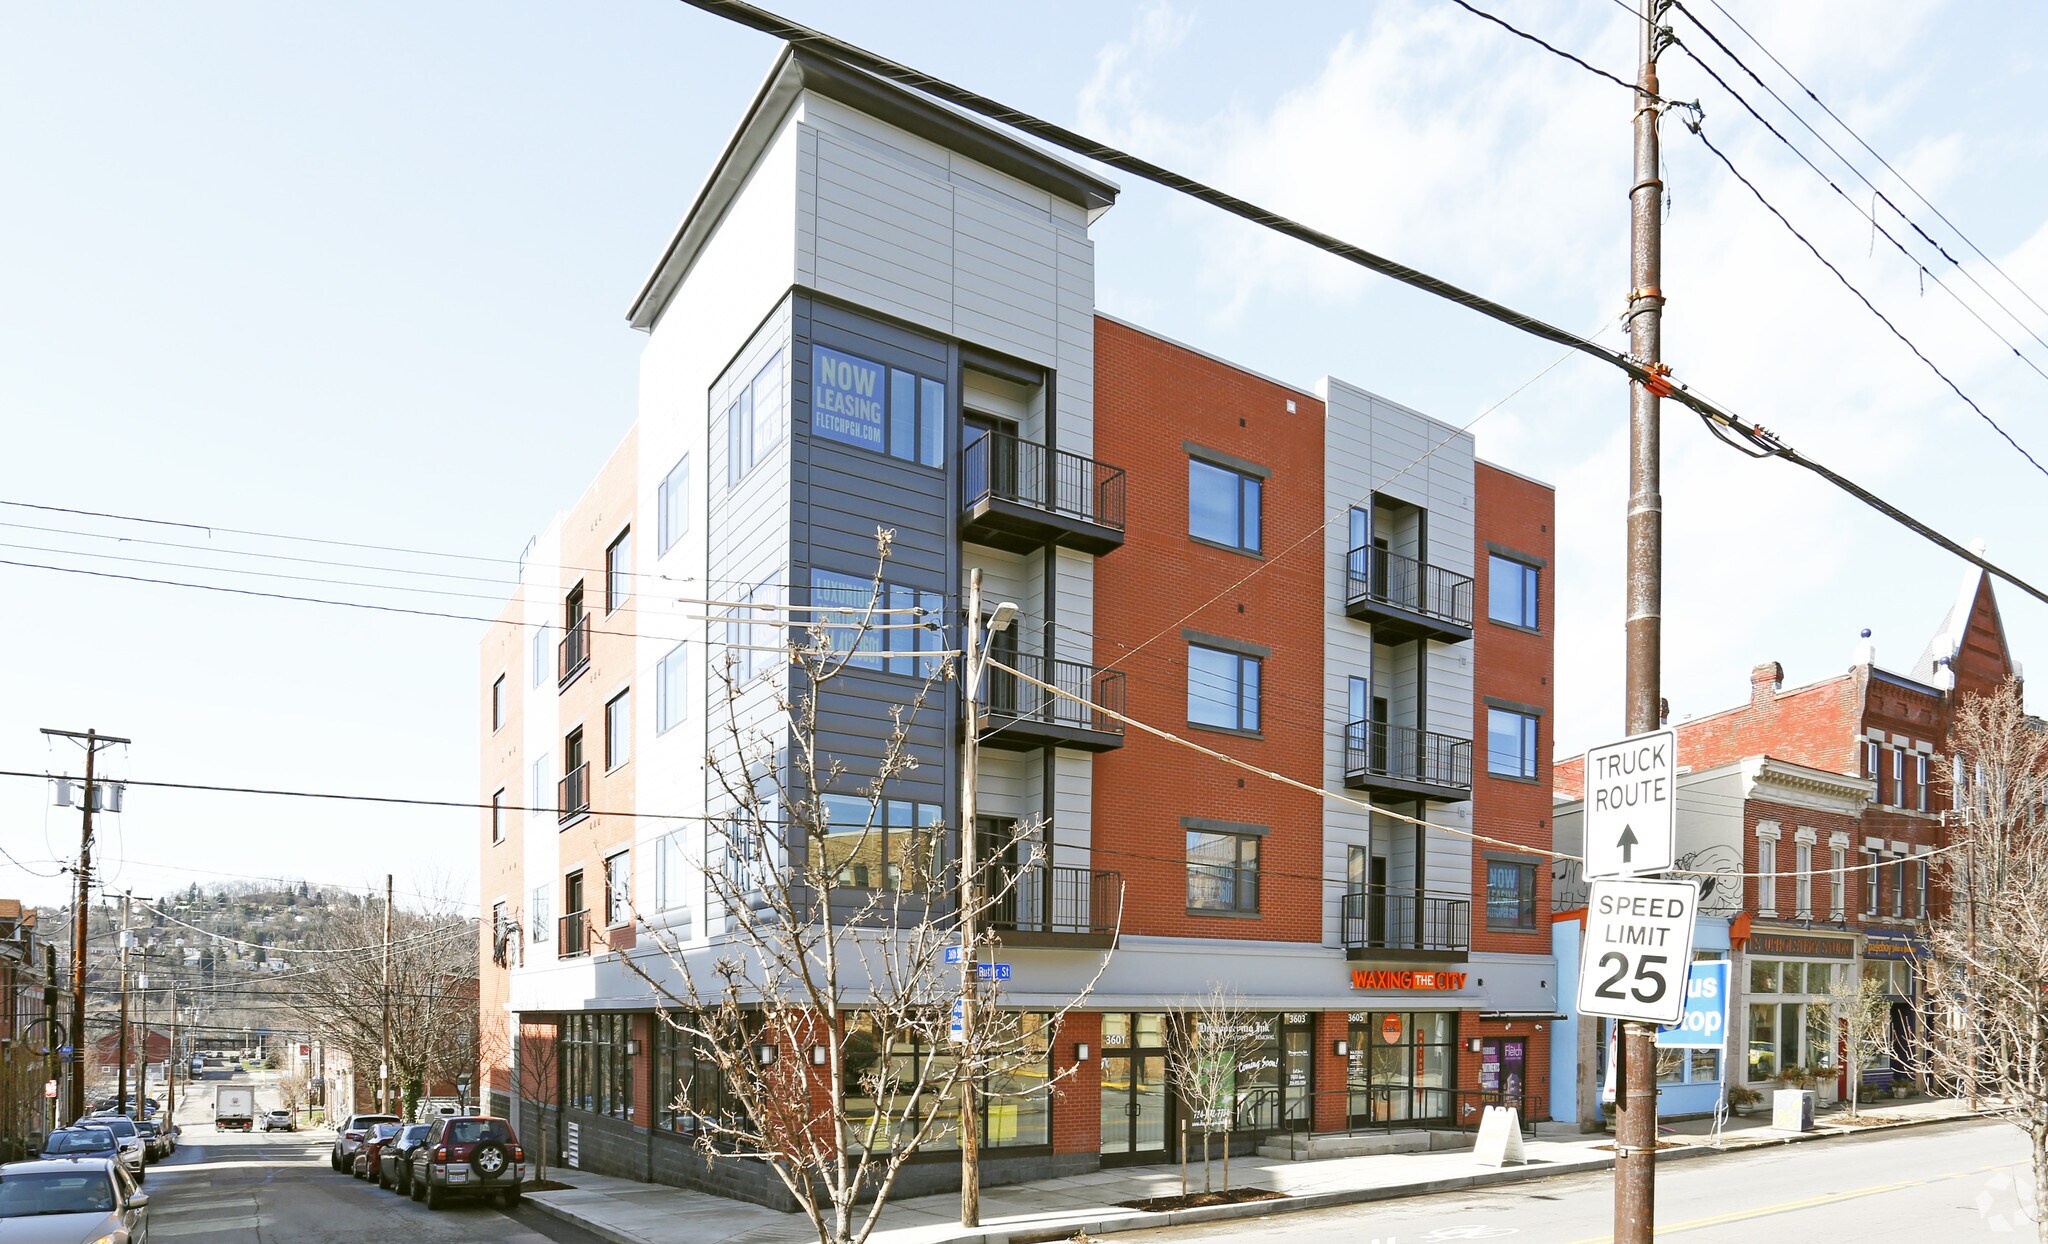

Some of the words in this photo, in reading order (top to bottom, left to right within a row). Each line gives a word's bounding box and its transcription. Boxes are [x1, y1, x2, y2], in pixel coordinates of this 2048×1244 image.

[821, 356, 876, 398] NOW
[816, 386, 881, 424] LEASING
[816, 411, 881, 444] FLETCHPGH.COM
[1596, 743, 1666, 780] TRUCK
[1596, 777, 1666, 812] ROUTE
[1599, 895, 1684, 918] SPEED
[1605, 924, 1671, 947] LIMIT
[979, 966, 999, 977] Butlr
[1001, 966, 1010, 977] St
[1352, 969, 1413, 989] WAXING
[1415, 975, 1434, 986] THE
[1435, 971, 1469, 990] CITY
[1594, 951, 1668, 1004] 25
[1687, 977, 1718, 999] us
[1289, 1014, 1306, 1023] 3603
[1348, 1013, 1364, 1022] 3605
[1105, 1035, 1126, 1045] 3601
[1239, 1060, 1261, 1073] Coming
